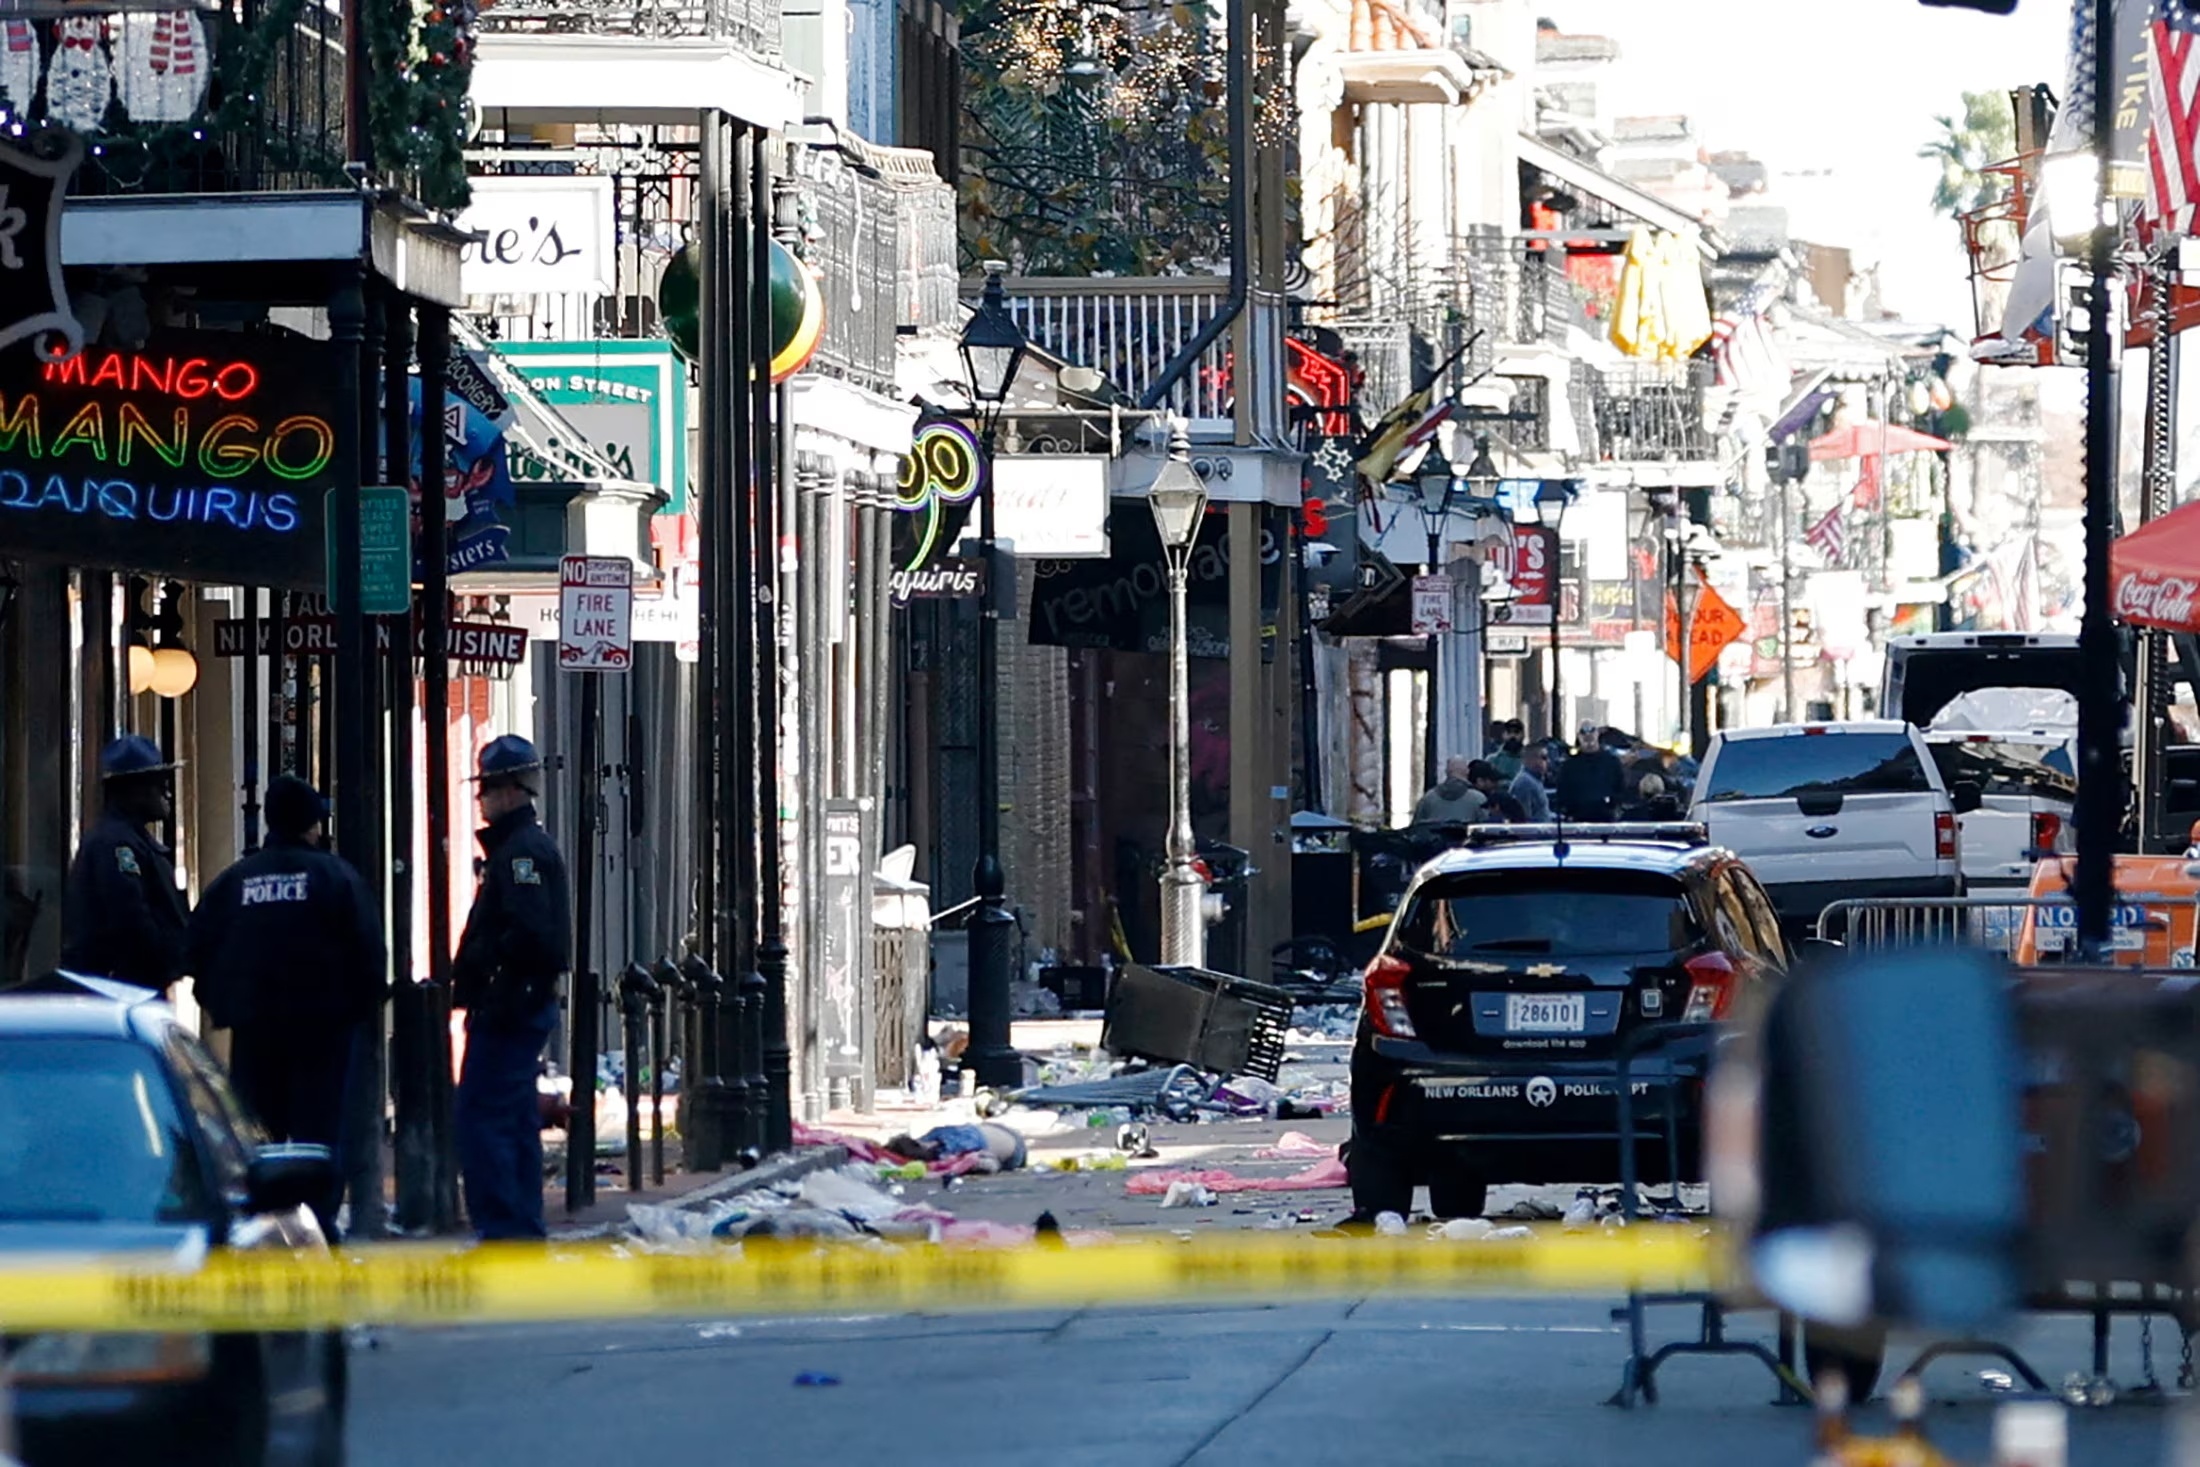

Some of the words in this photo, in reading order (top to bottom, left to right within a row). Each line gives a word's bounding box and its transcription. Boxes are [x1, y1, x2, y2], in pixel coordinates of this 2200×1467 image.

[45, 347, 257, 399] MANGO
[569, 375, 652, 404] STREET
[449, 539, 496, 571] sters
[563, 561, 586, 583] NO
[577, 593, 615, 612] FIRE
[573, 618, 616, 637] LANE
[241, 881, 308, 906] POLICE
[1520, 1004, 1579, 1023] 286101
[1503, 1038, 1549, 1049] download
[1551, 1038, 1566, 1048] the
[1425, 1087, 1455, 1098] NEW
[1457, 1085, 1519, 1098] ORLEANS
